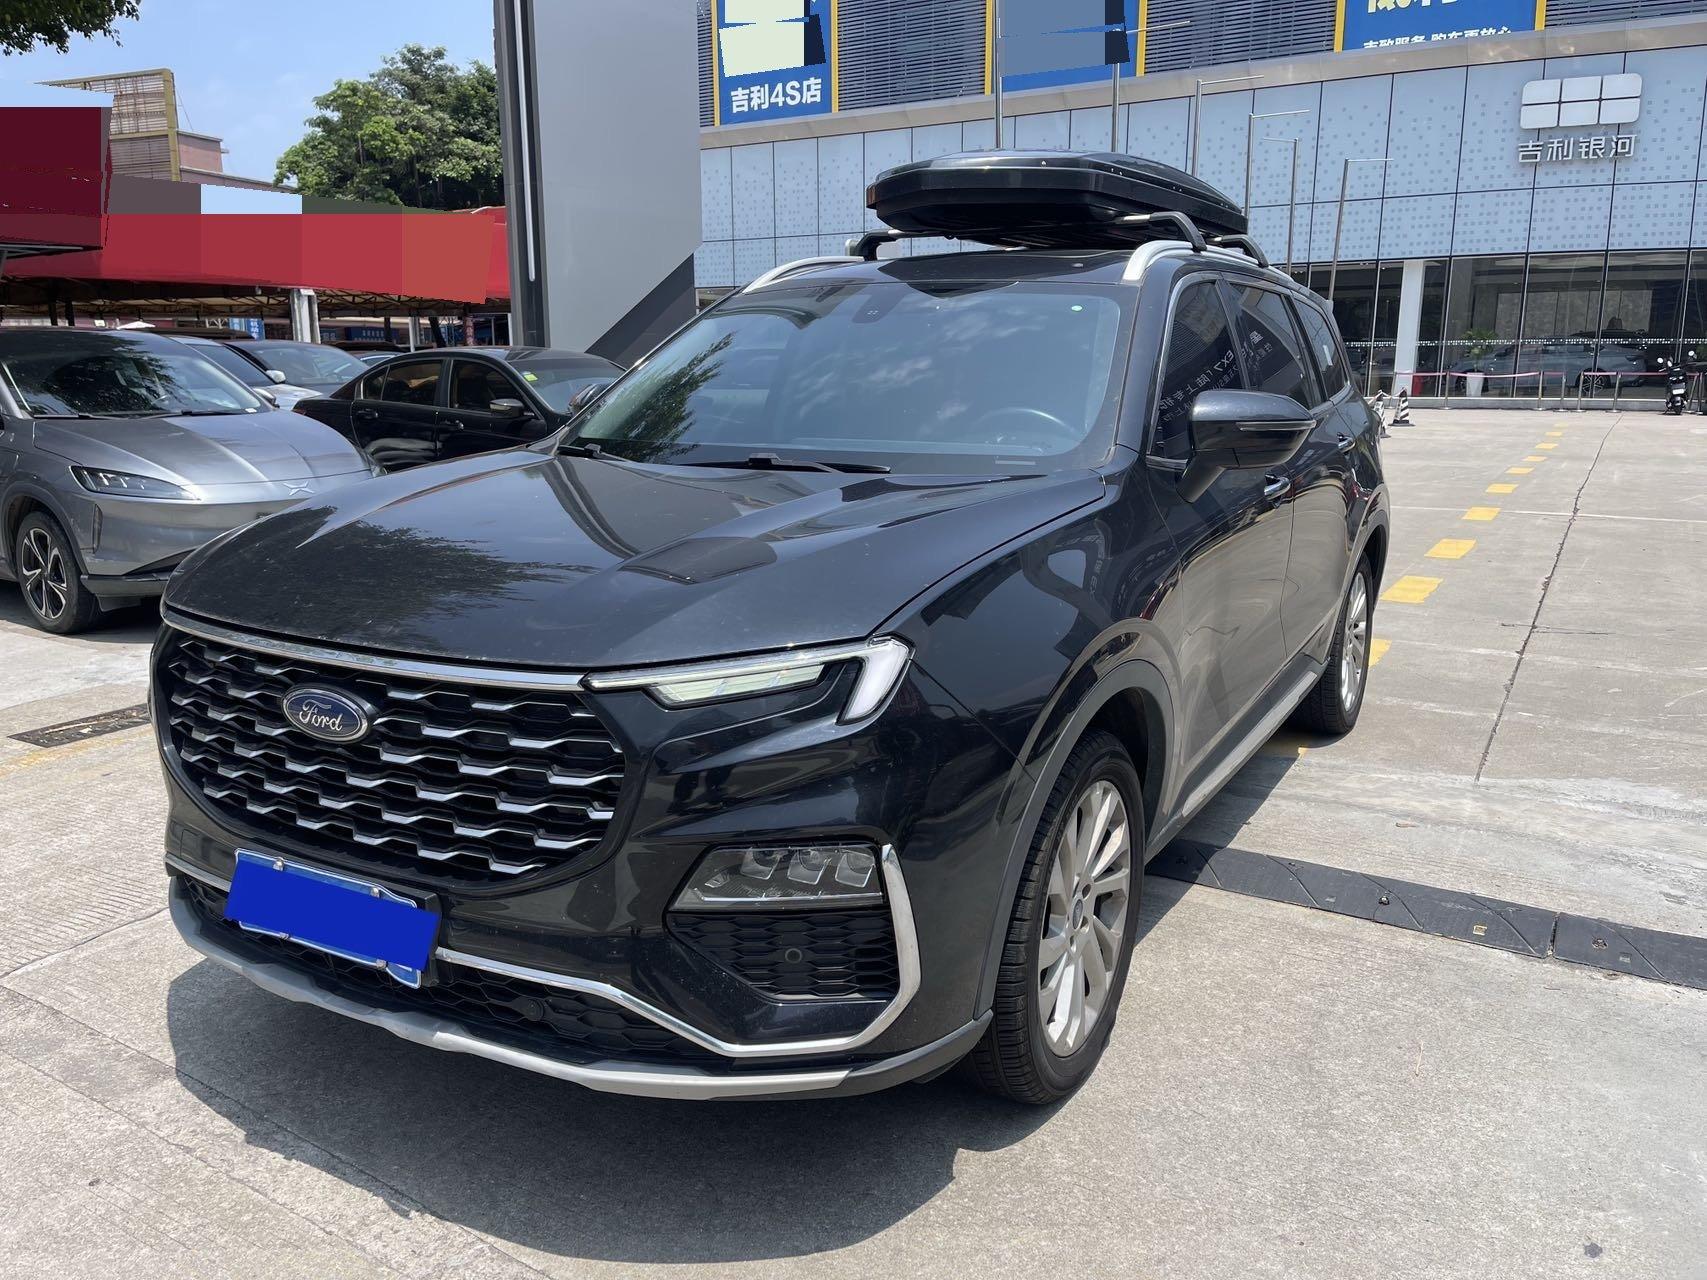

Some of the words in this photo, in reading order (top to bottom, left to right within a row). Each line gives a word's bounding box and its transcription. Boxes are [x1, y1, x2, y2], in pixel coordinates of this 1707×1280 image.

[730, 76, 822, 114] 吉利4S店
[1517, 134, 1638, 163] 吉利银河
[299, 699, 343, 731] Ford
